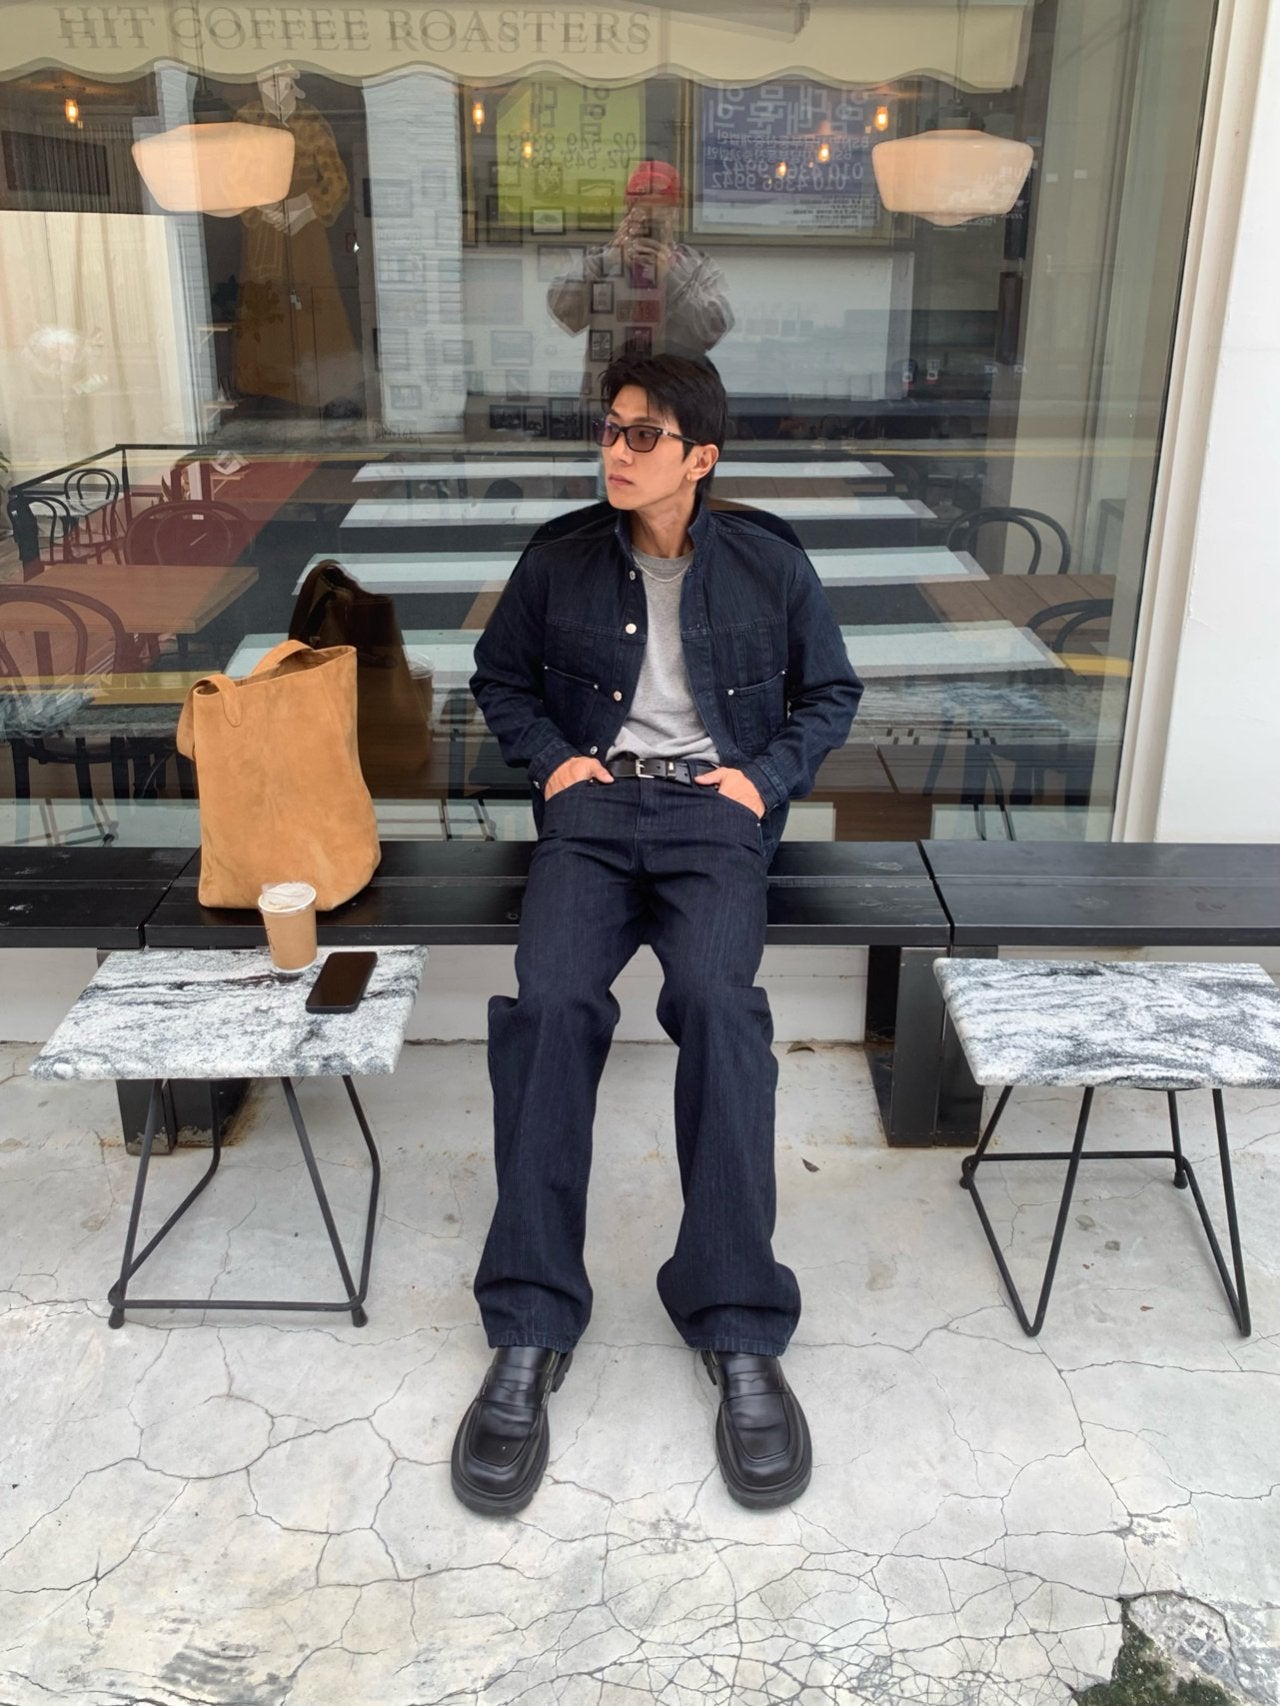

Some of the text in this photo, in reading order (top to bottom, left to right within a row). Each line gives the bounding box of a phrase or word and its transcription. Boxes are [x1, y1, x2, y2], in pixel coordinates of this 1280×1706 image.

[53, 7, 652, 54] HIT COFFEE ROASTERS
